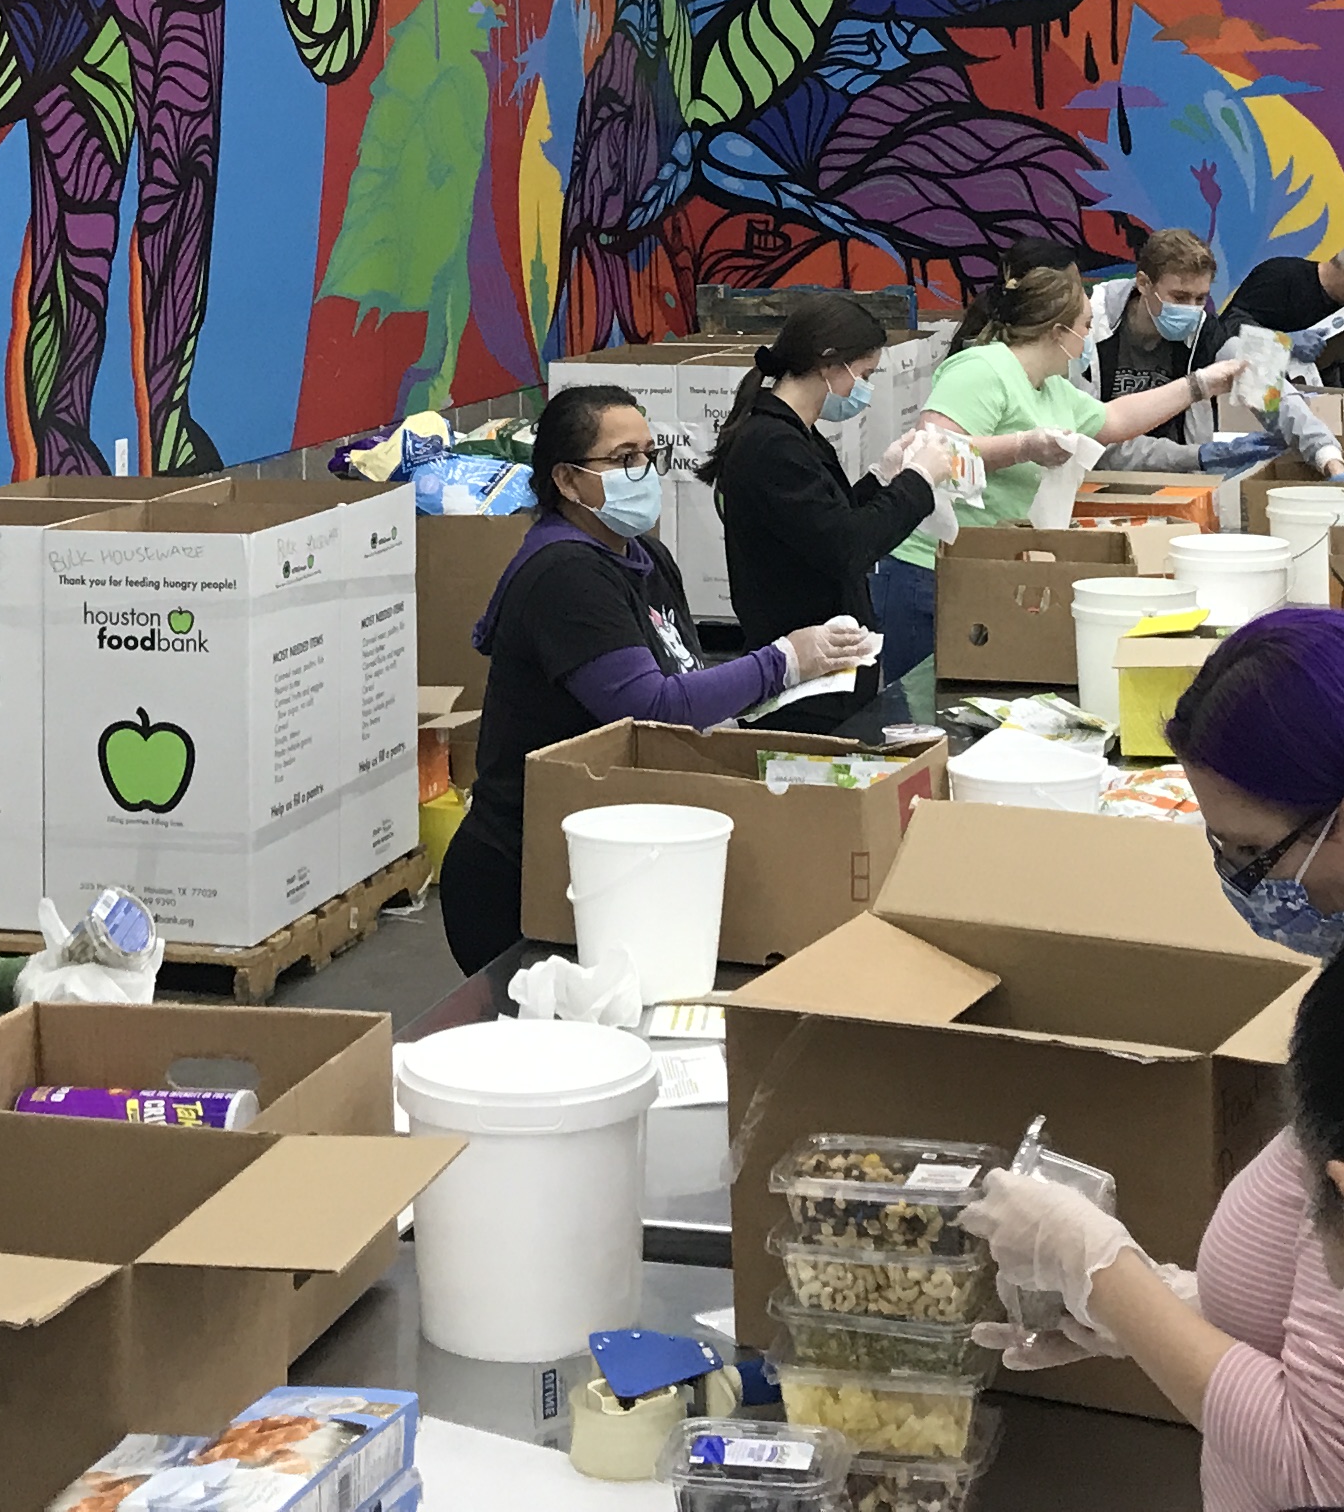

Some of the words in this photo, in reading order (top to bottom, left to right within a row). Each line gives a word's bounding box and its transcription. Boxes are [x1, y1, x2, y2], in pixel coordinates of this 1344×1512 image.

[657, 433, 692, 447] BULK
[58, 574, 87, 586] Thank
[89, 577, 107, 588] you
[109, 575, 122, 587] for
[125, 576, 160, 590] feeding
[163, 576, 198, 592] hungry
[200, 578, 238, 592] people!
[83, 601, 161, 627] houston
[97, 626, 210, 654] foodbank
[171, 1100, 204, 1128] Tak
[544, 1372, 556, 1417] ULINE
